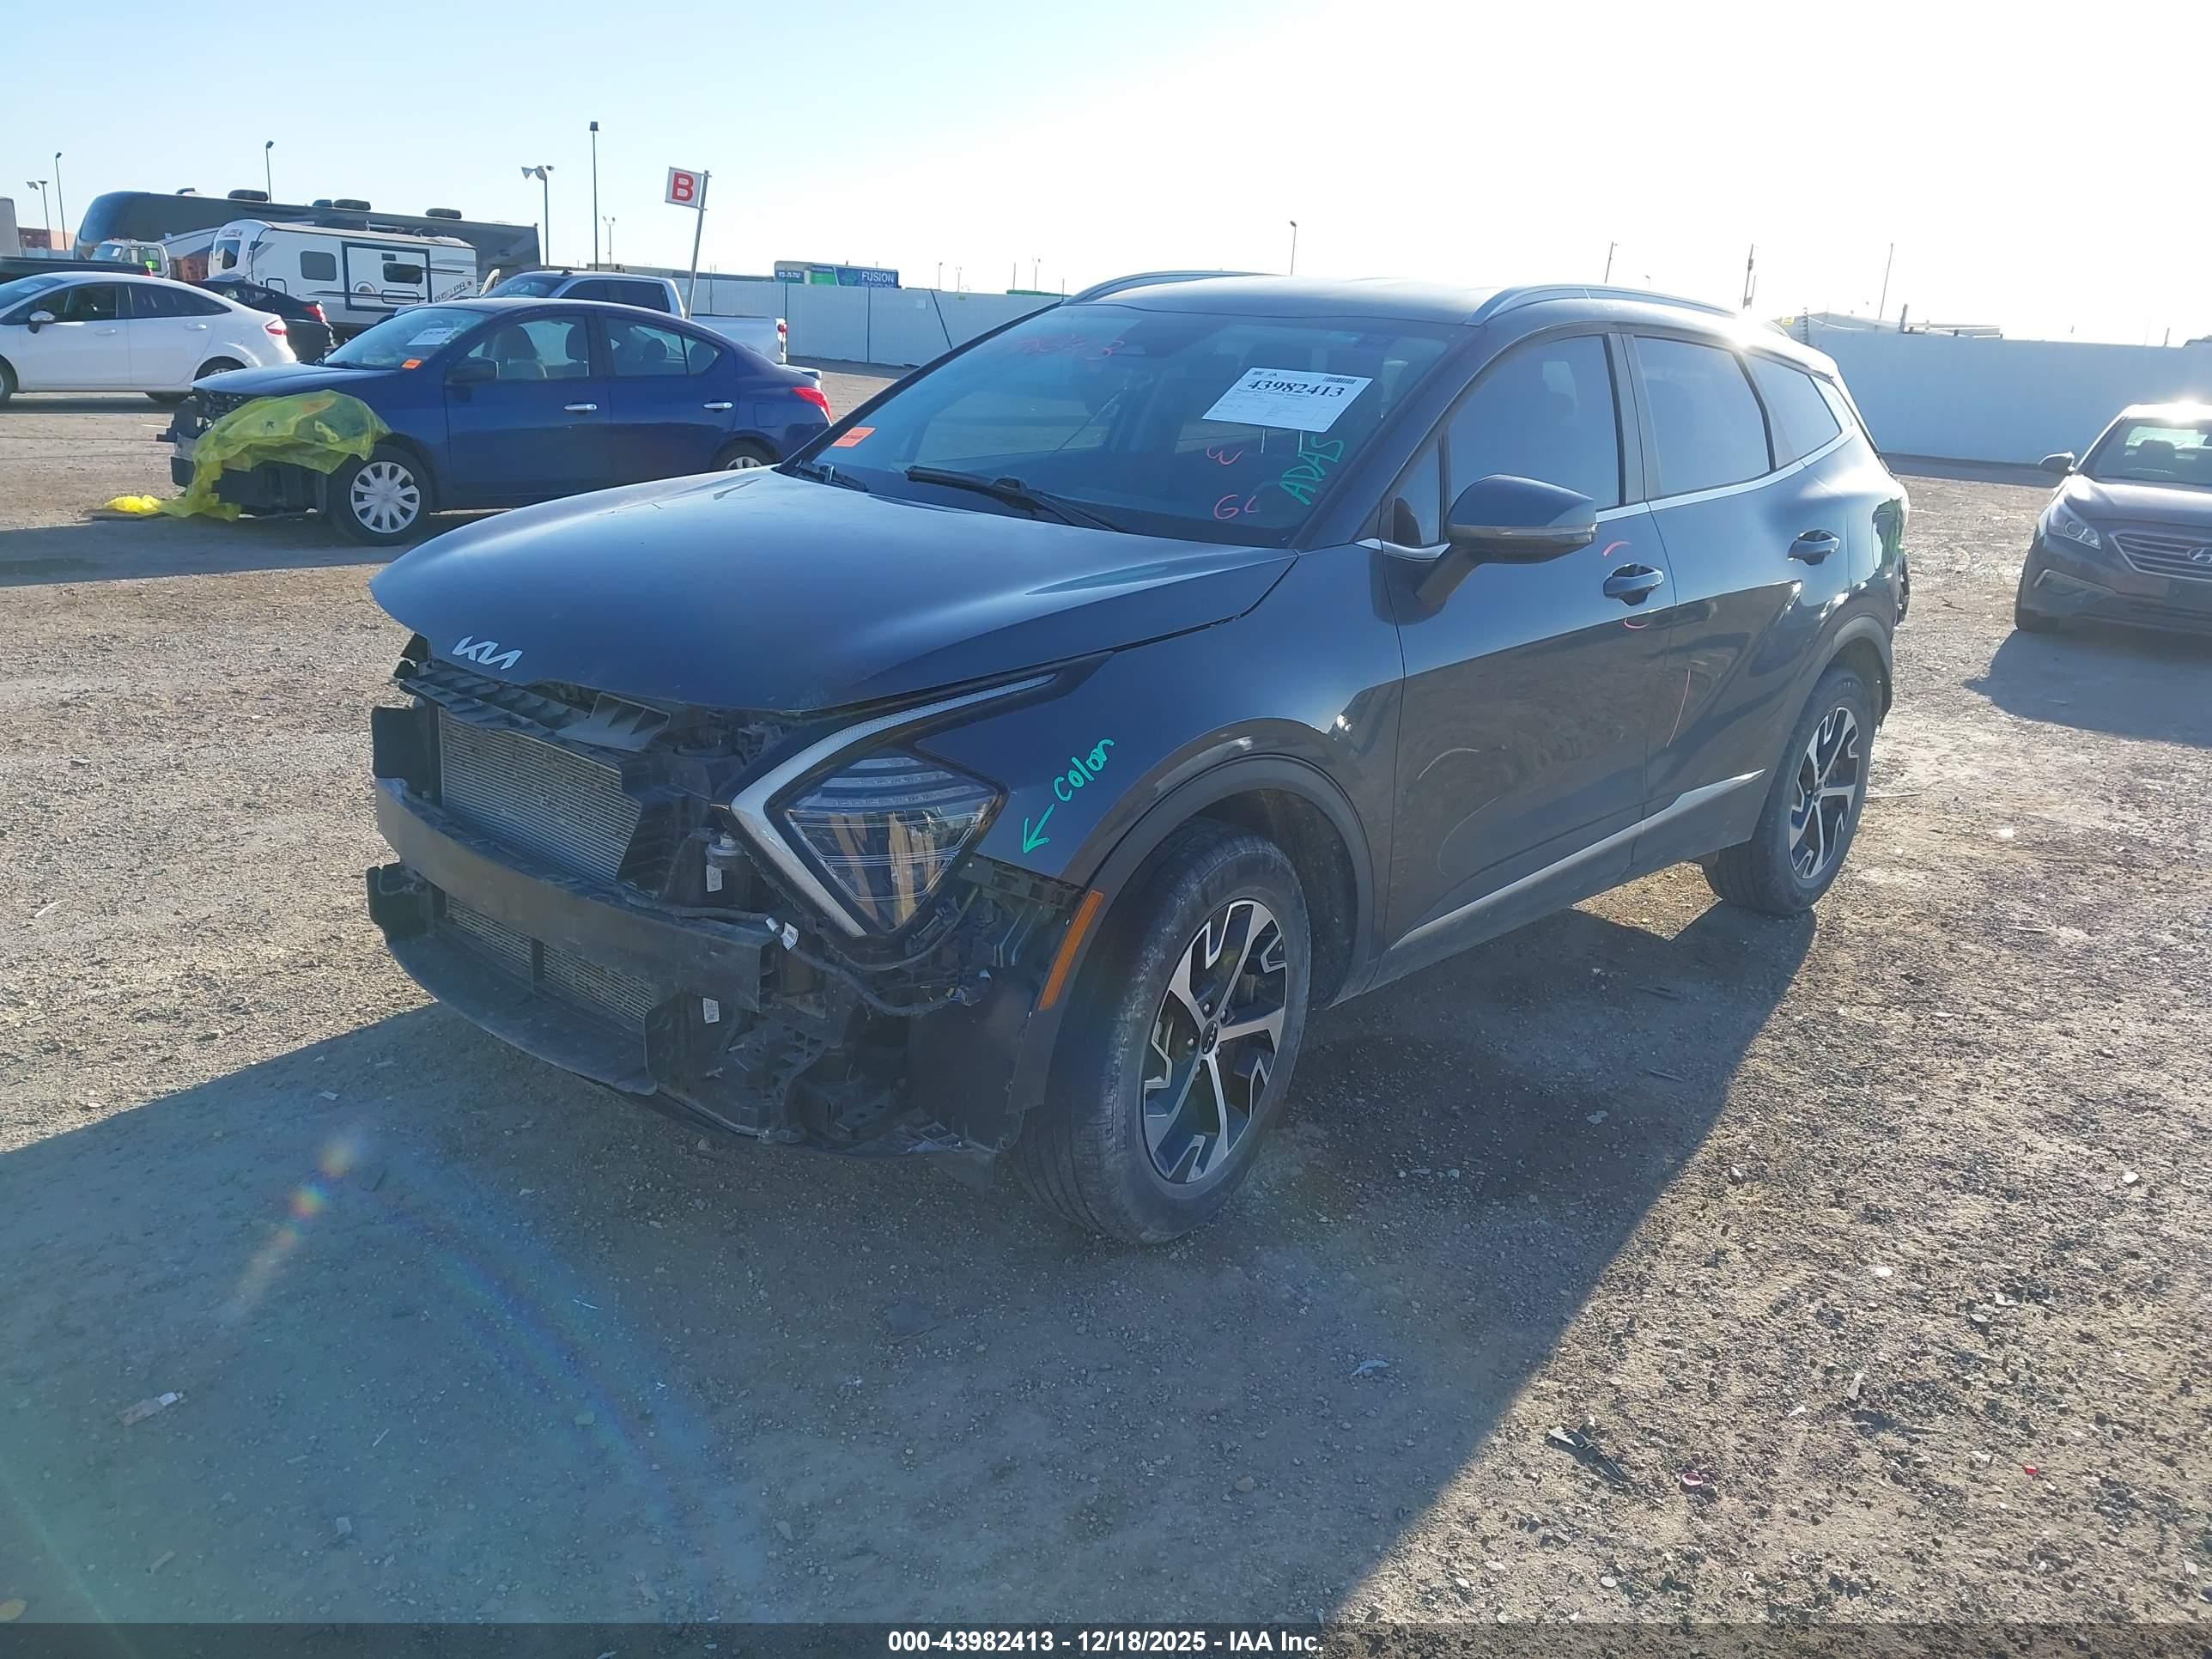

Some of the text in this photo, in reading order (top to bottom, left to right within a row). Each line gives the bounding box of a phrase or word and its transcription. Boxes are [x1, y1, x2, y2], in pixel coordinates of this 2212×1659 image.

[672, 172, 694, 202] B
[861, 270, 895, 283] FUSION
[1248, 379, 1346, 398] 43982413
[1279, 435, 1345, 506] ADAS
[452, 635, 523, 671] KIA
